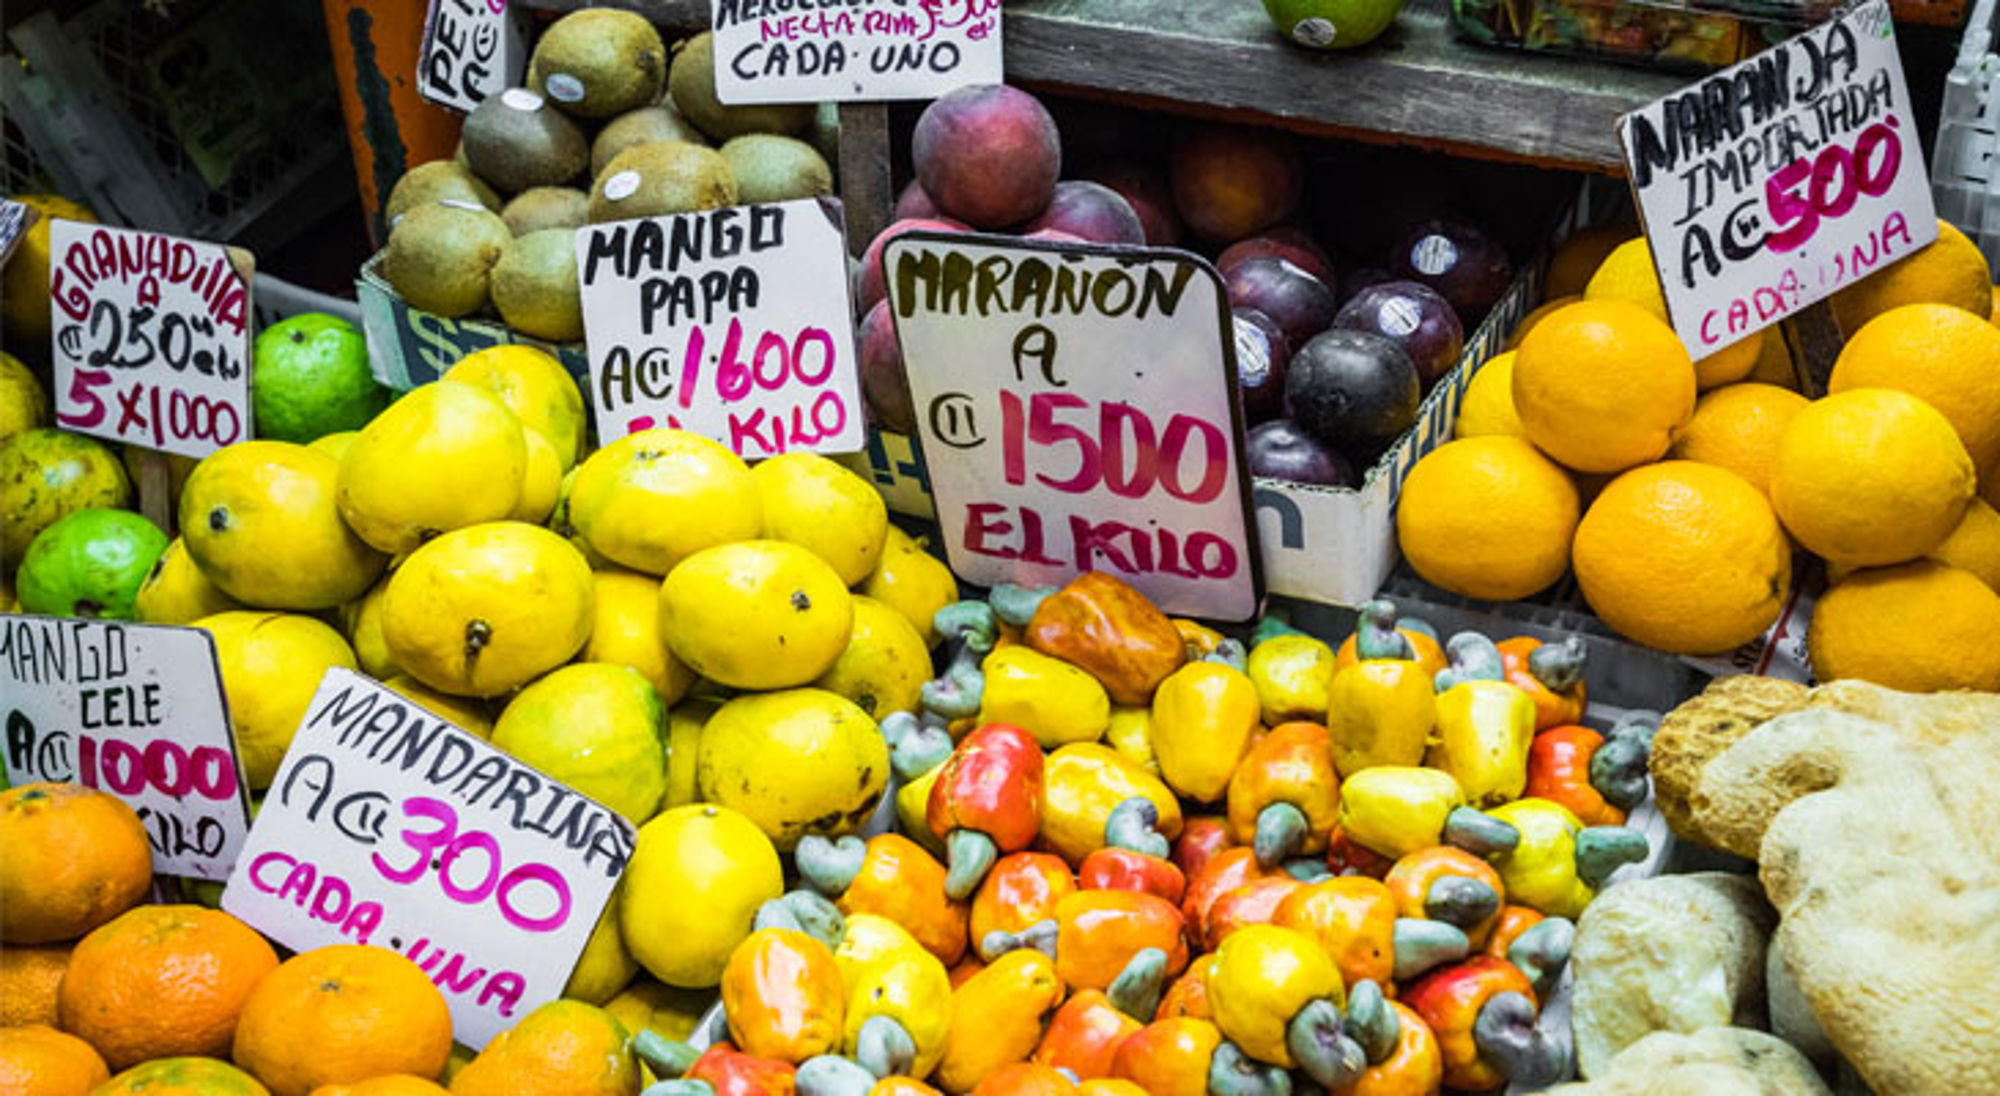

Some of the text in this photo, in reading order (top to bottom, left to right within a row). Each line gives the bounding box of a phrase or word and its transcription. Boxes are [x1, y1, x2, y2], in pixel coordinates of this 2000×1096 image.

[731, 41, 960, 80] CADA UNO
[1631, 22, 1858, 187] NARANJA
[1673, 69, 1892, 226] IMPORTADA
[584, 206, 785, 285] MANGO
[137, 276, 159, 307] A
[640, 266, 760, 335] PAPA
[1700, 269, 1799, 346] CADA
[1013, 324, 1067, 387] A
[728, 391, 846, 456] KILO
[963, 504, 1067, 566] EL
[1069, 515, 1238, 579] KILO
[80, 684, 160, 728] CELE
[307, 686, 635, 877] MANDARINA
[249, 851, 528, 1018] CADA UNA
